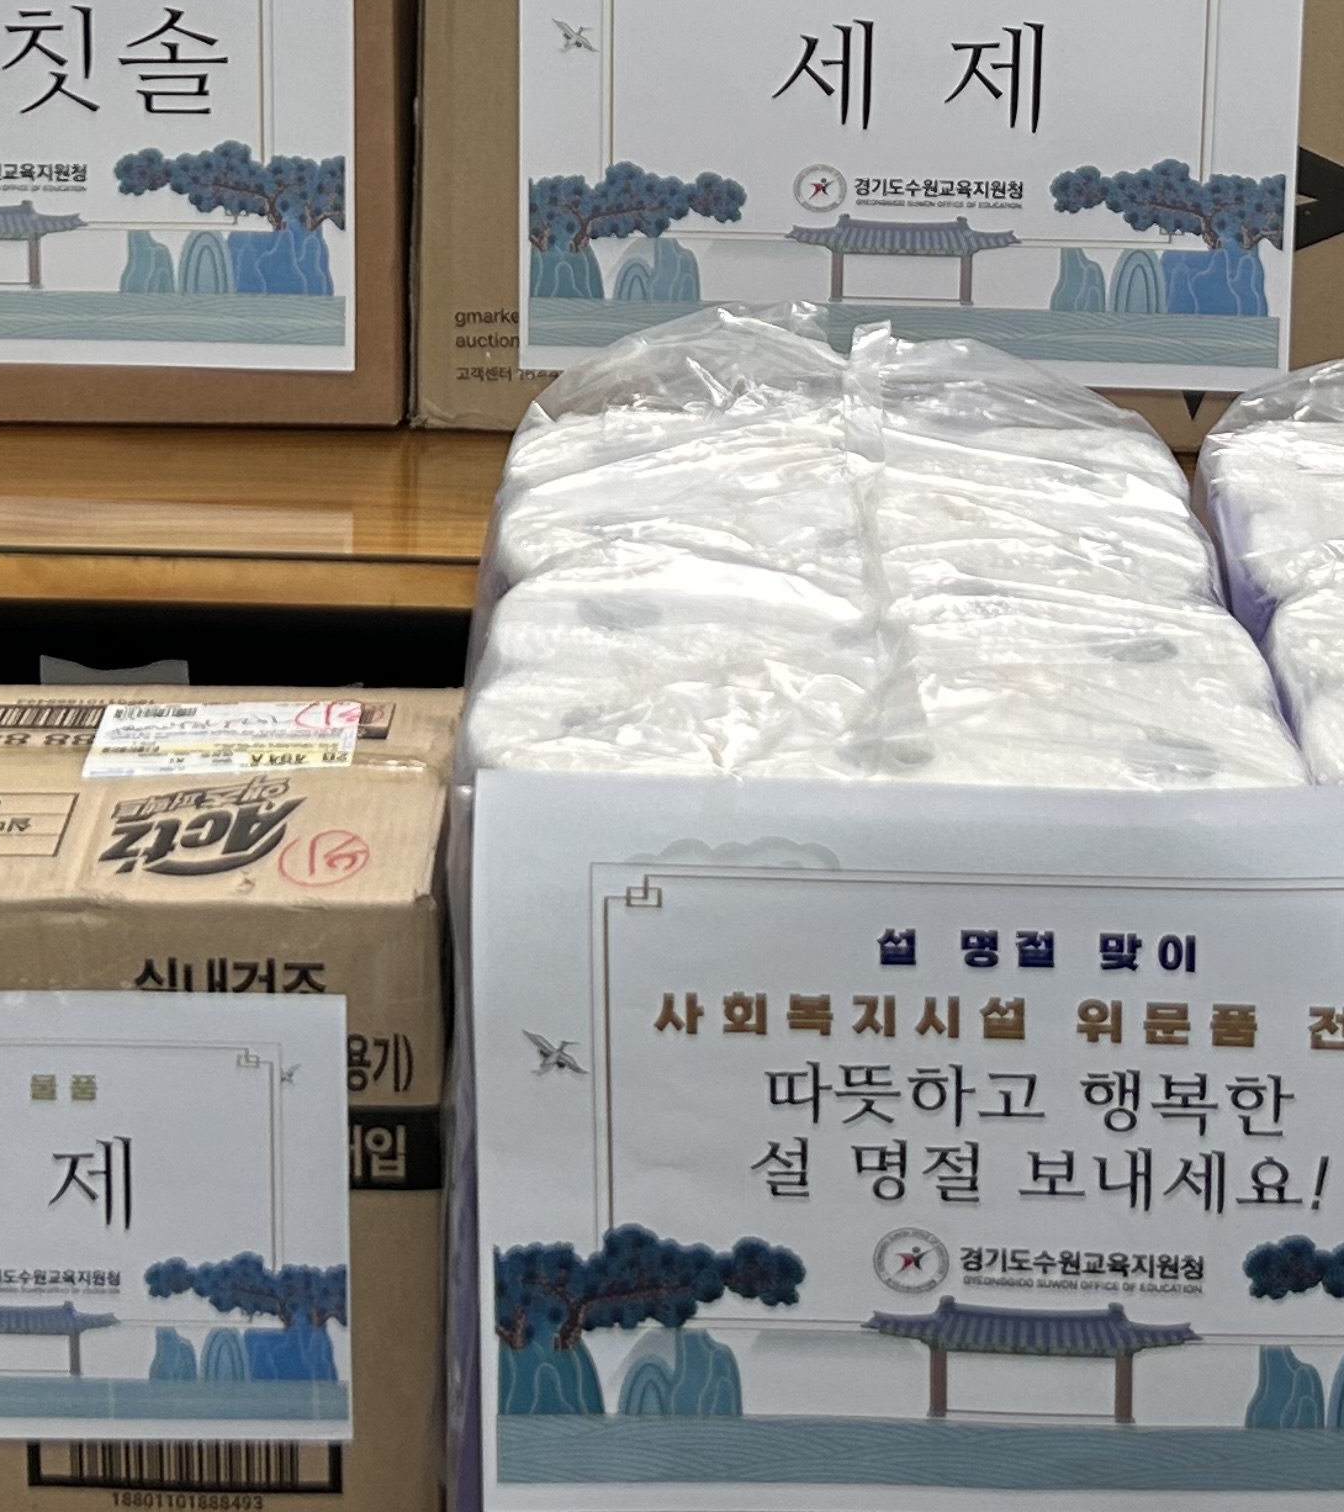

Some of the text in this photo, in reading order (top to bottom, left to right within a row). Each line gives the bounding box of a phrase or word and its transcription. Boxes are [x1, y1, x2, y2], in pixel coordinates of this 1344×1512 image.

[854, 178, 1024, 199] 경기도수원교육지원청
[456, 333, 520, 348] auction
[457, 366, 513, 382] 고객센터
[876, 927, 1200, 974] 설 명절 맞이
[654, 991, 1028, 1042] 사회복지시설
[1075, 998, 1260, 1050] 위문품
[764, 1060, 1296, 1141] 따뜻하고 행복한
[750, 1136, 1332, 1215] 설 명절 보내세요!
[960, 1246, 1205, 1280] 경기도수원교육지원청
[1140, 1282, 1203, 1294] EDUCATION
